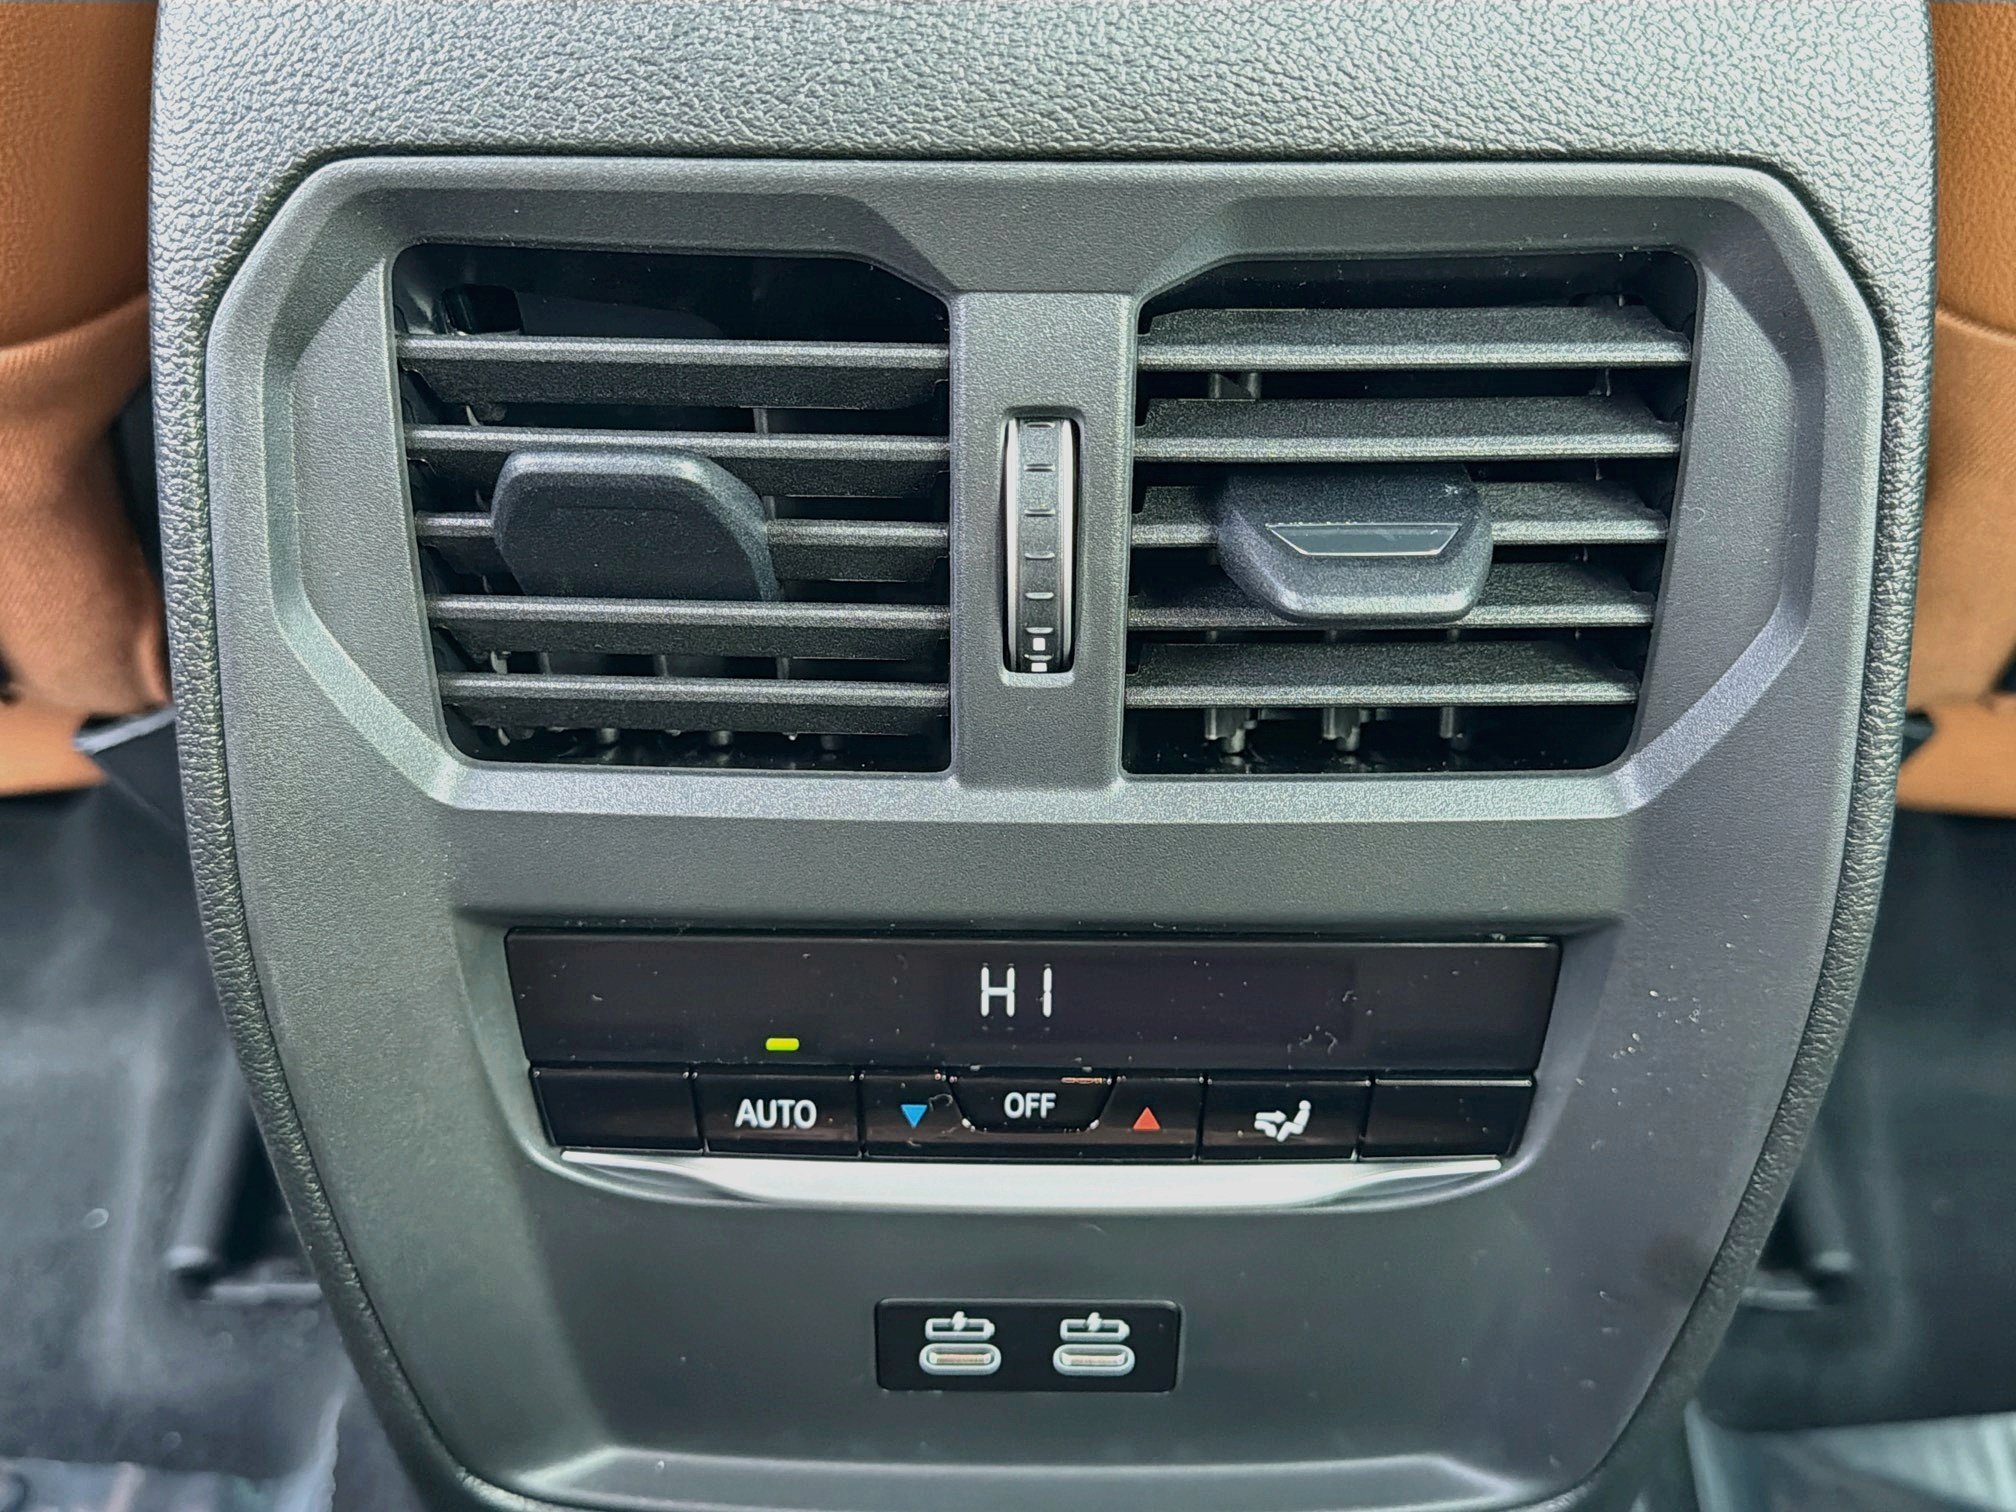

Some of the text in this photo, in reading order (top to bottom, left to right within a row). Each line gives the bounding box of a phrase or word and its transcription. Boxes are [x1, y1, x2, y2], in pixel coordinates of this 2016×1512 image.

[980, 966, 1053, 1018] HI
[734, 1098, 818, 1130] AUTO
[1003, 1091, 1057, 1119] OFF
